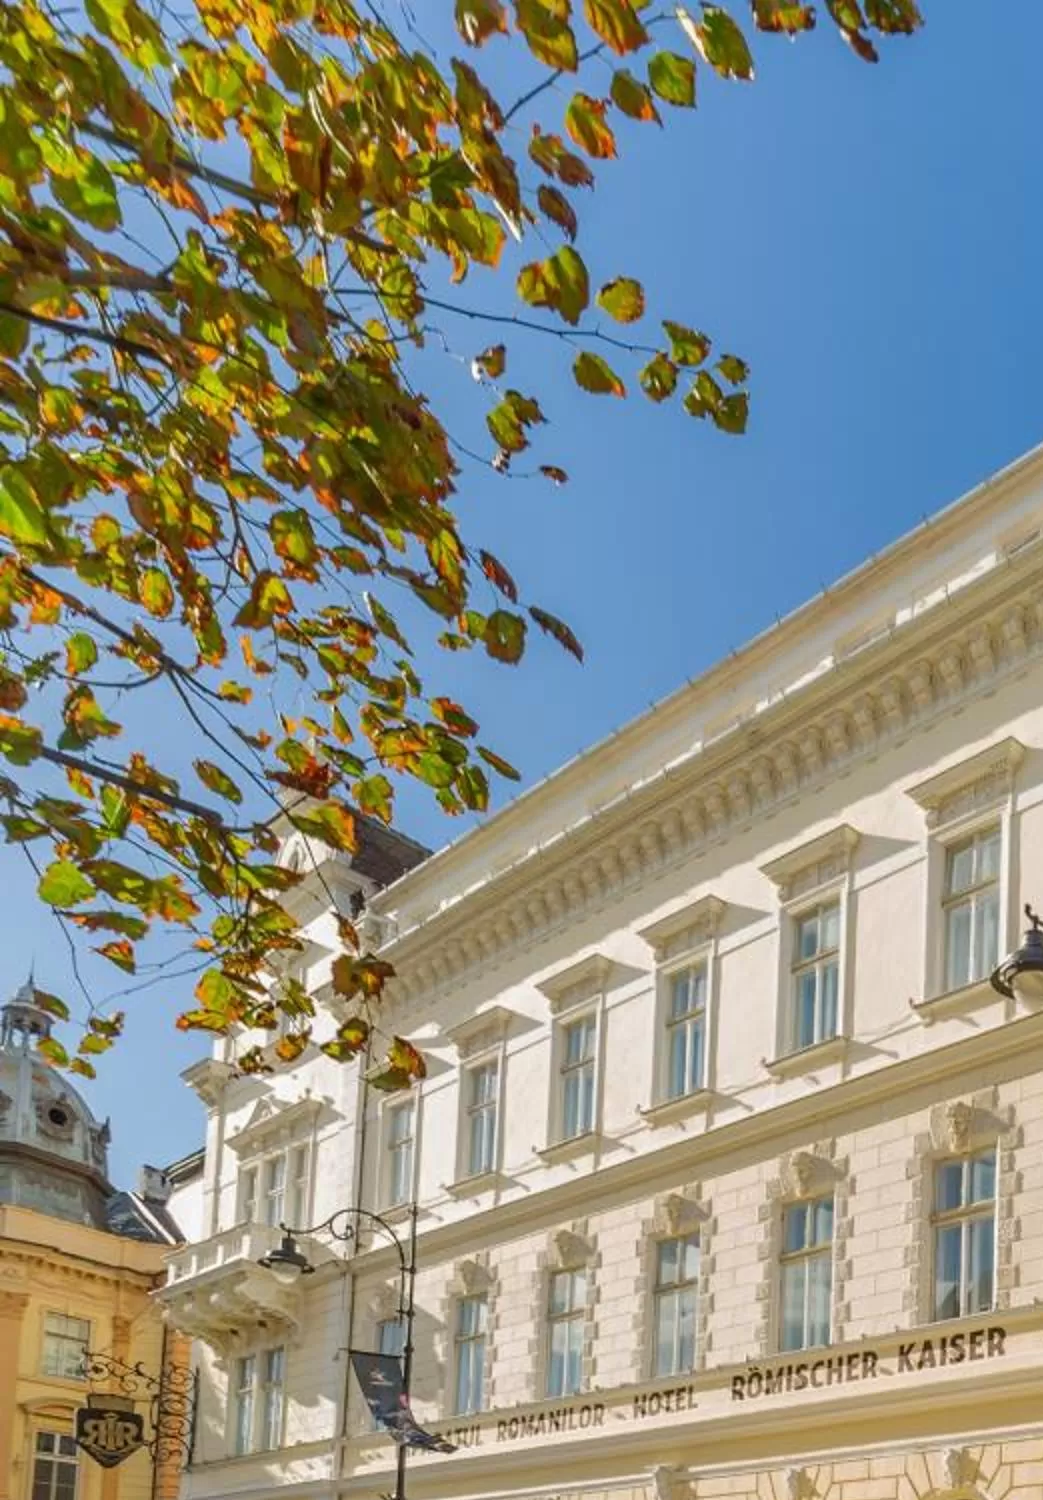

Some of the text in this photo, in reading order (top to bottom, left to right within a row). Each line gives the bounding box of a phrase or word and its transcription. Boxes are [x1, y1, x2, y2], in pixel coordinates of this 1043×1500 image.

[496, 1403, 606, 1443] ROMANILOR
[633, 1384, 699, 1419] HOTEL
[731, 1350, 879, 1401] RÖMISCHER
[897, 1326, 1007, 1374] KAISER
